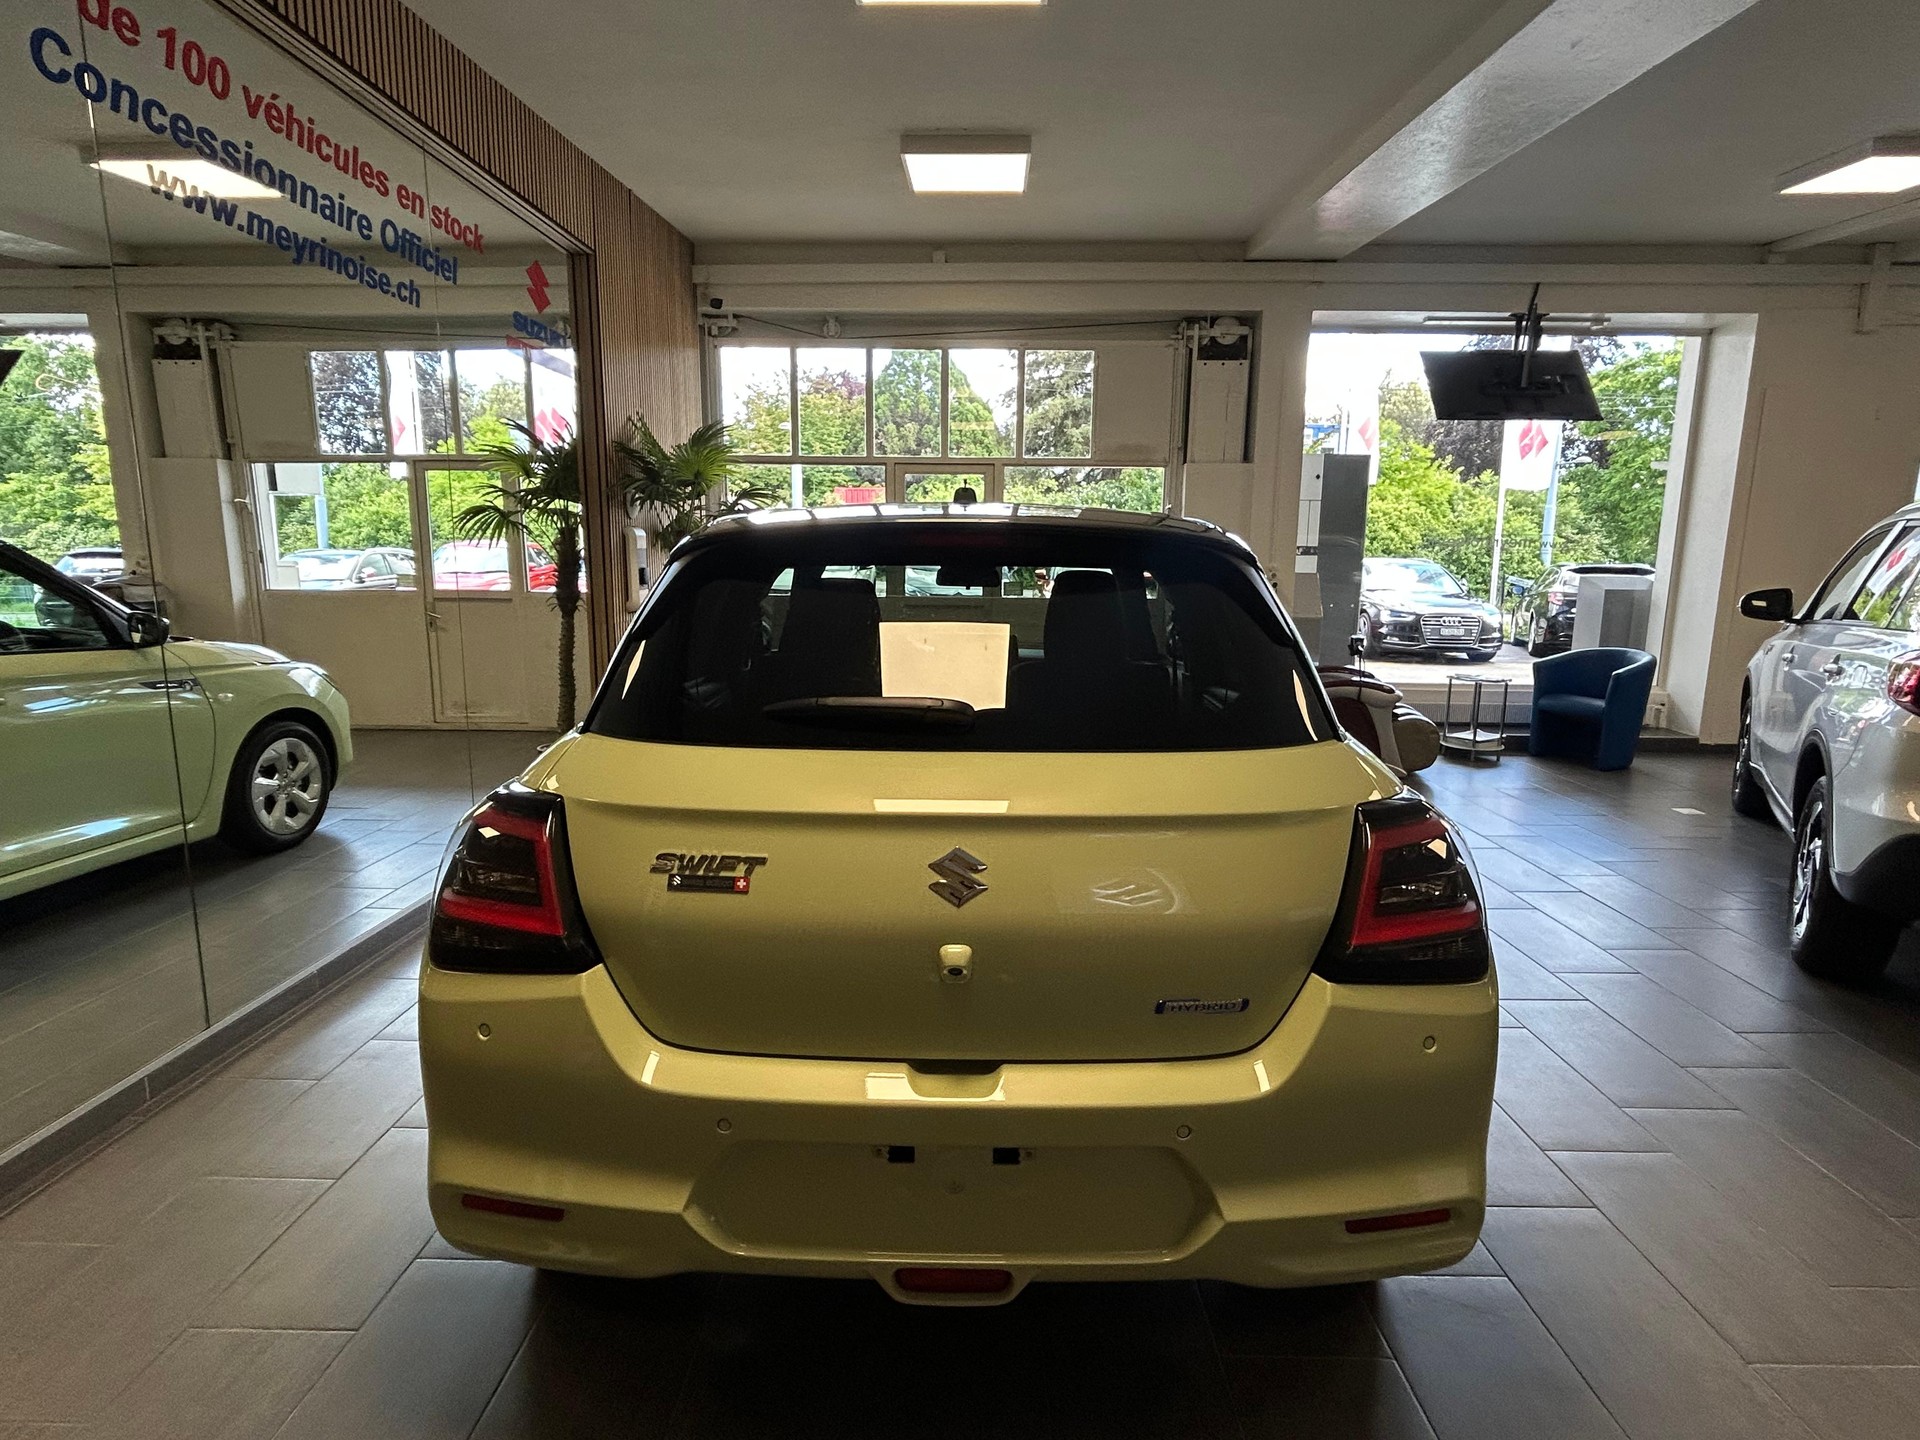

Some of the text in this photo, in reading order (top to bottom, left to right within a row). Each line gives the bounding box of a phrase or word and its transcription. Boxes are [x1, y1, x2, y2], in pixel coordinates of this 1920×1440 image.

[29, 26, 458, 286] Concessionnaire Officiel
[77, 0, 485, 254] de 100 véhicules en stock
[146, 164, 421, 309] www.meyrinoise.ch
[649, 852, 769, 877] SWIFT
